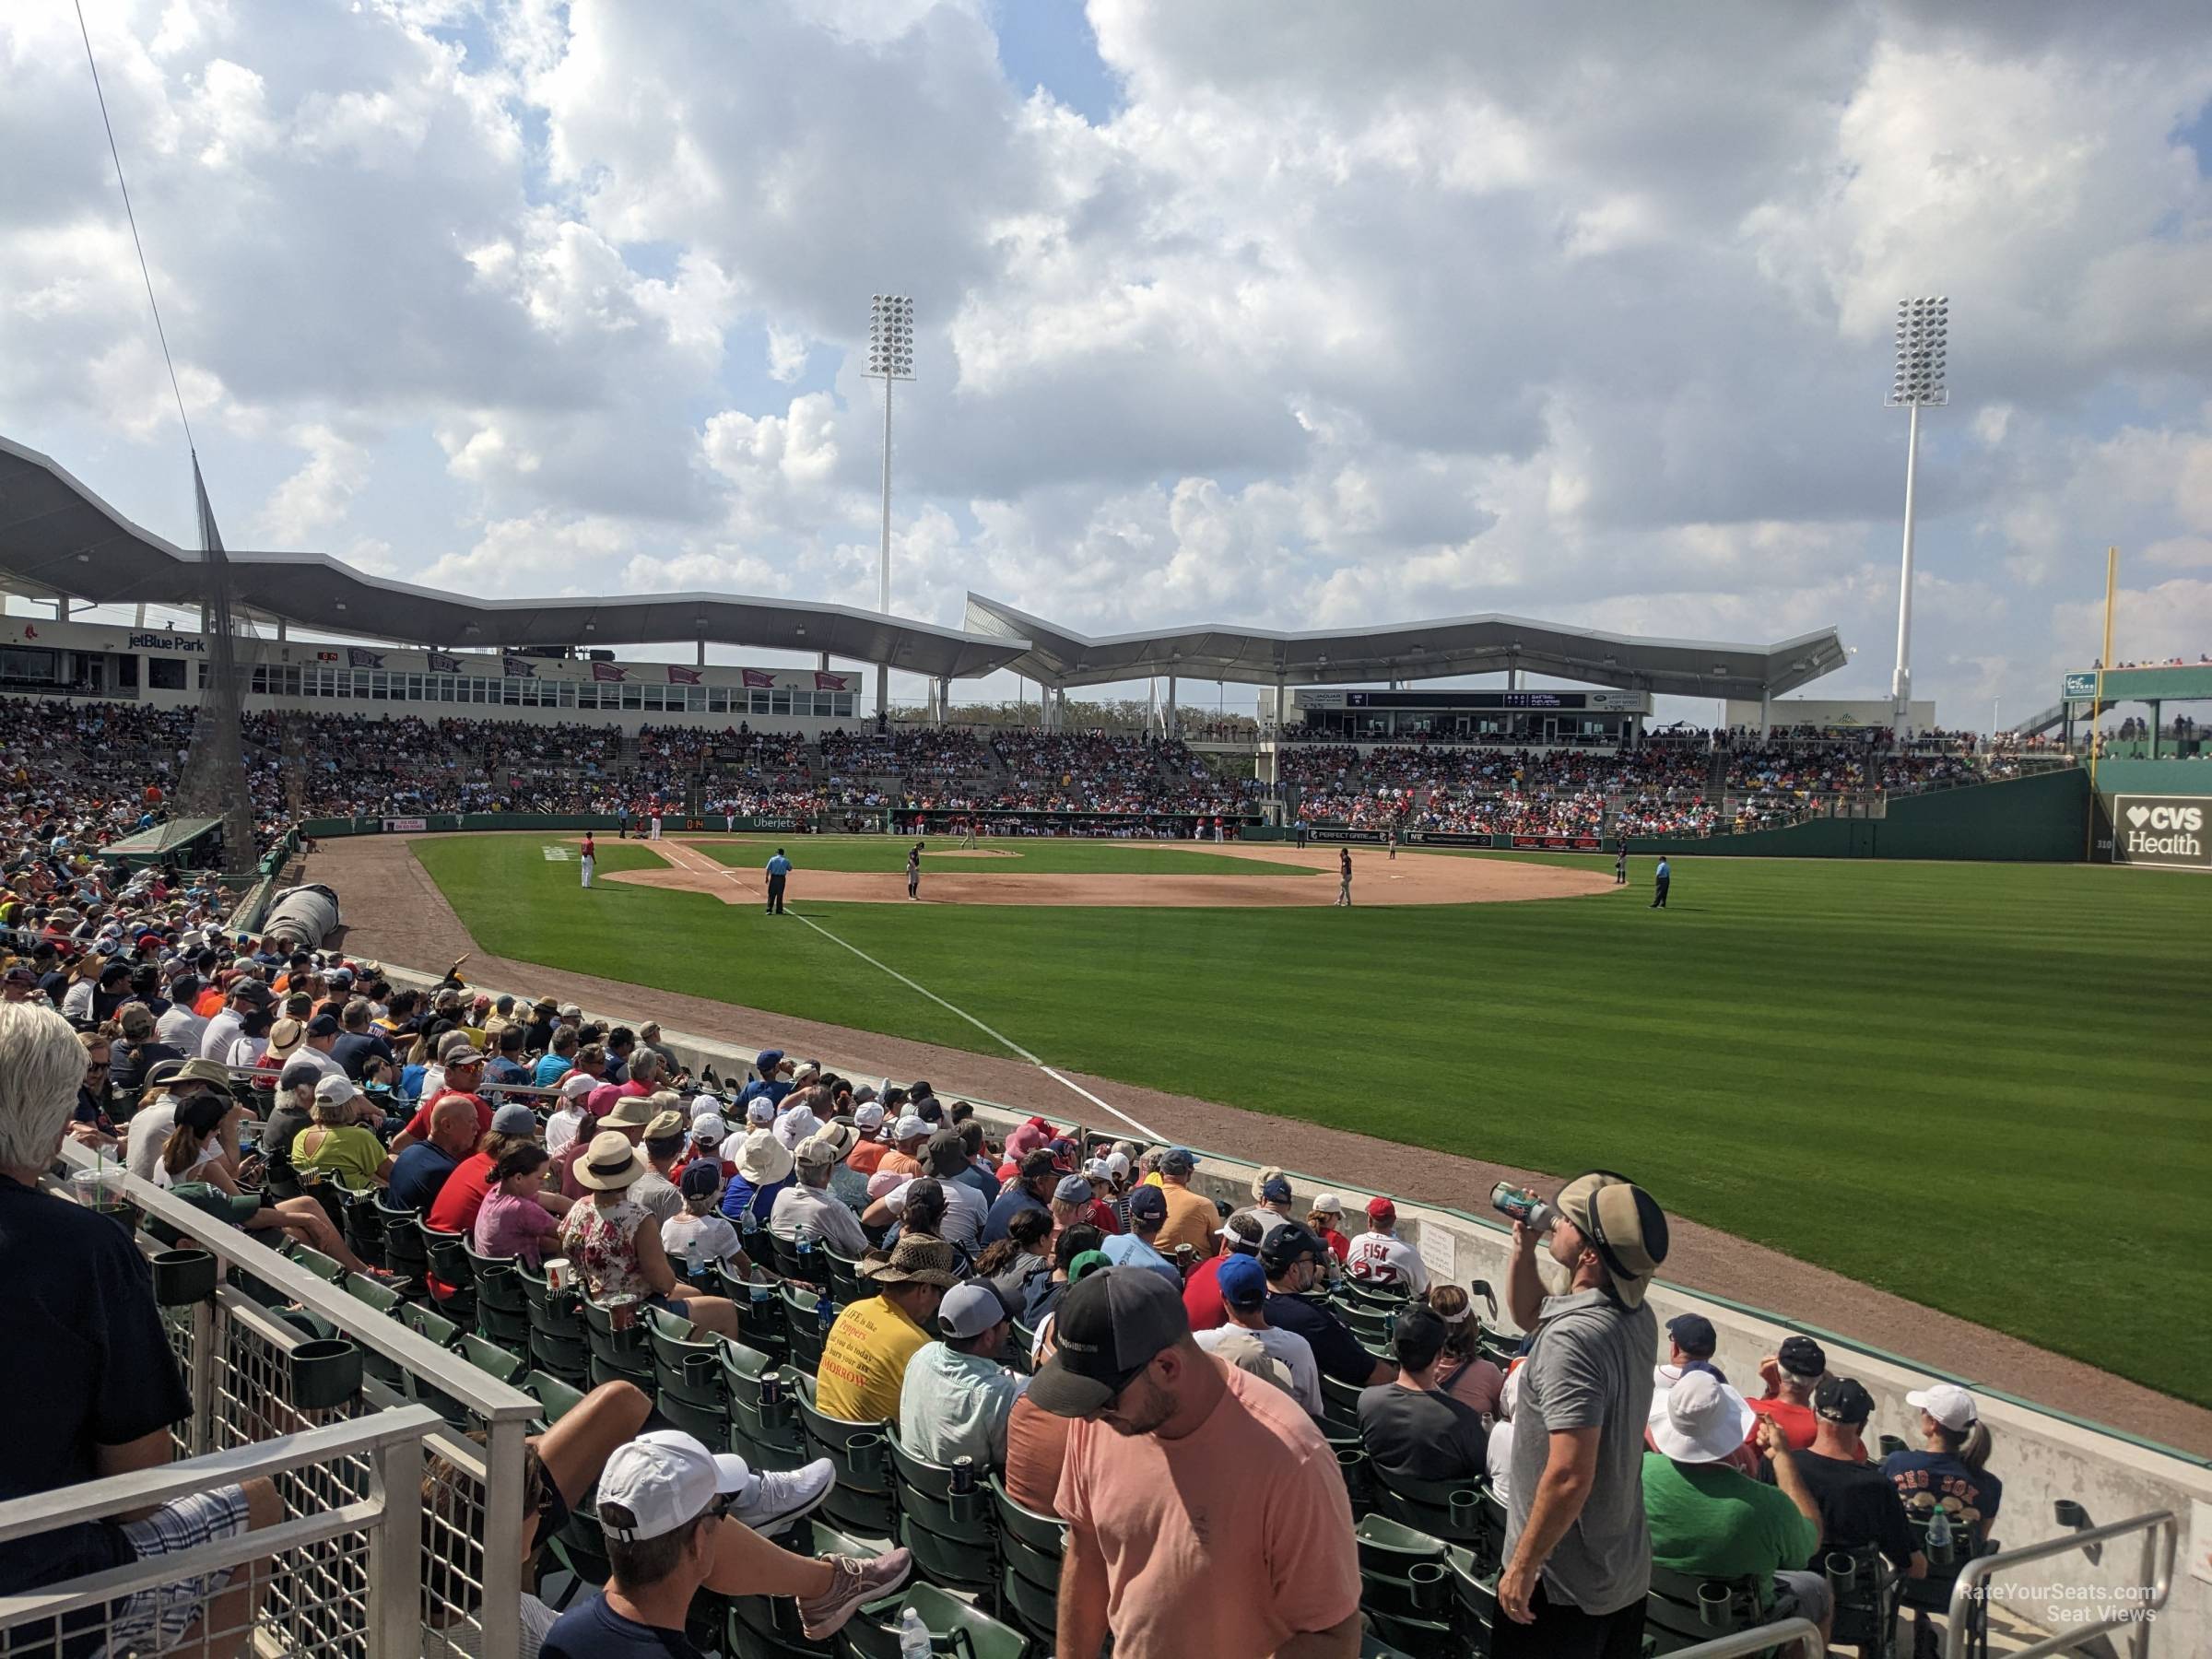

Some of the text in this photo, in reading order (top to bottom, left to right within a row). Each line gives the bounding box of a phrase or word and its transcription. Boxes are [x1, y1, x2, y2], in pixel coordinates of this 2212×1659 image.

[128, 633, 205, 652] jetBlue Park
[754, 818, 796, 829] UberJets
[2150, 806, 2202, 831] CVS
[2096, 840, 2112, 849] 310
[2127, 830, 2201, 855] Health
[1364, 1243, 1390, 1262] FISK
[1354, 1262, 1397, 1284] 27
[840, 1320, 867, 1340] Peppers
[844, 1308, 864, 1323] LIFE
[865, 1320, 877, 1333] like
[830, 1347, 869, 1373] burn your ass
[836, 1338, 846, 1347] you
[846, 1343, 853, 1351] do
[853, 1347, 874, 1363] today
[1894, 1469, 1981, 1505] RED SOX
